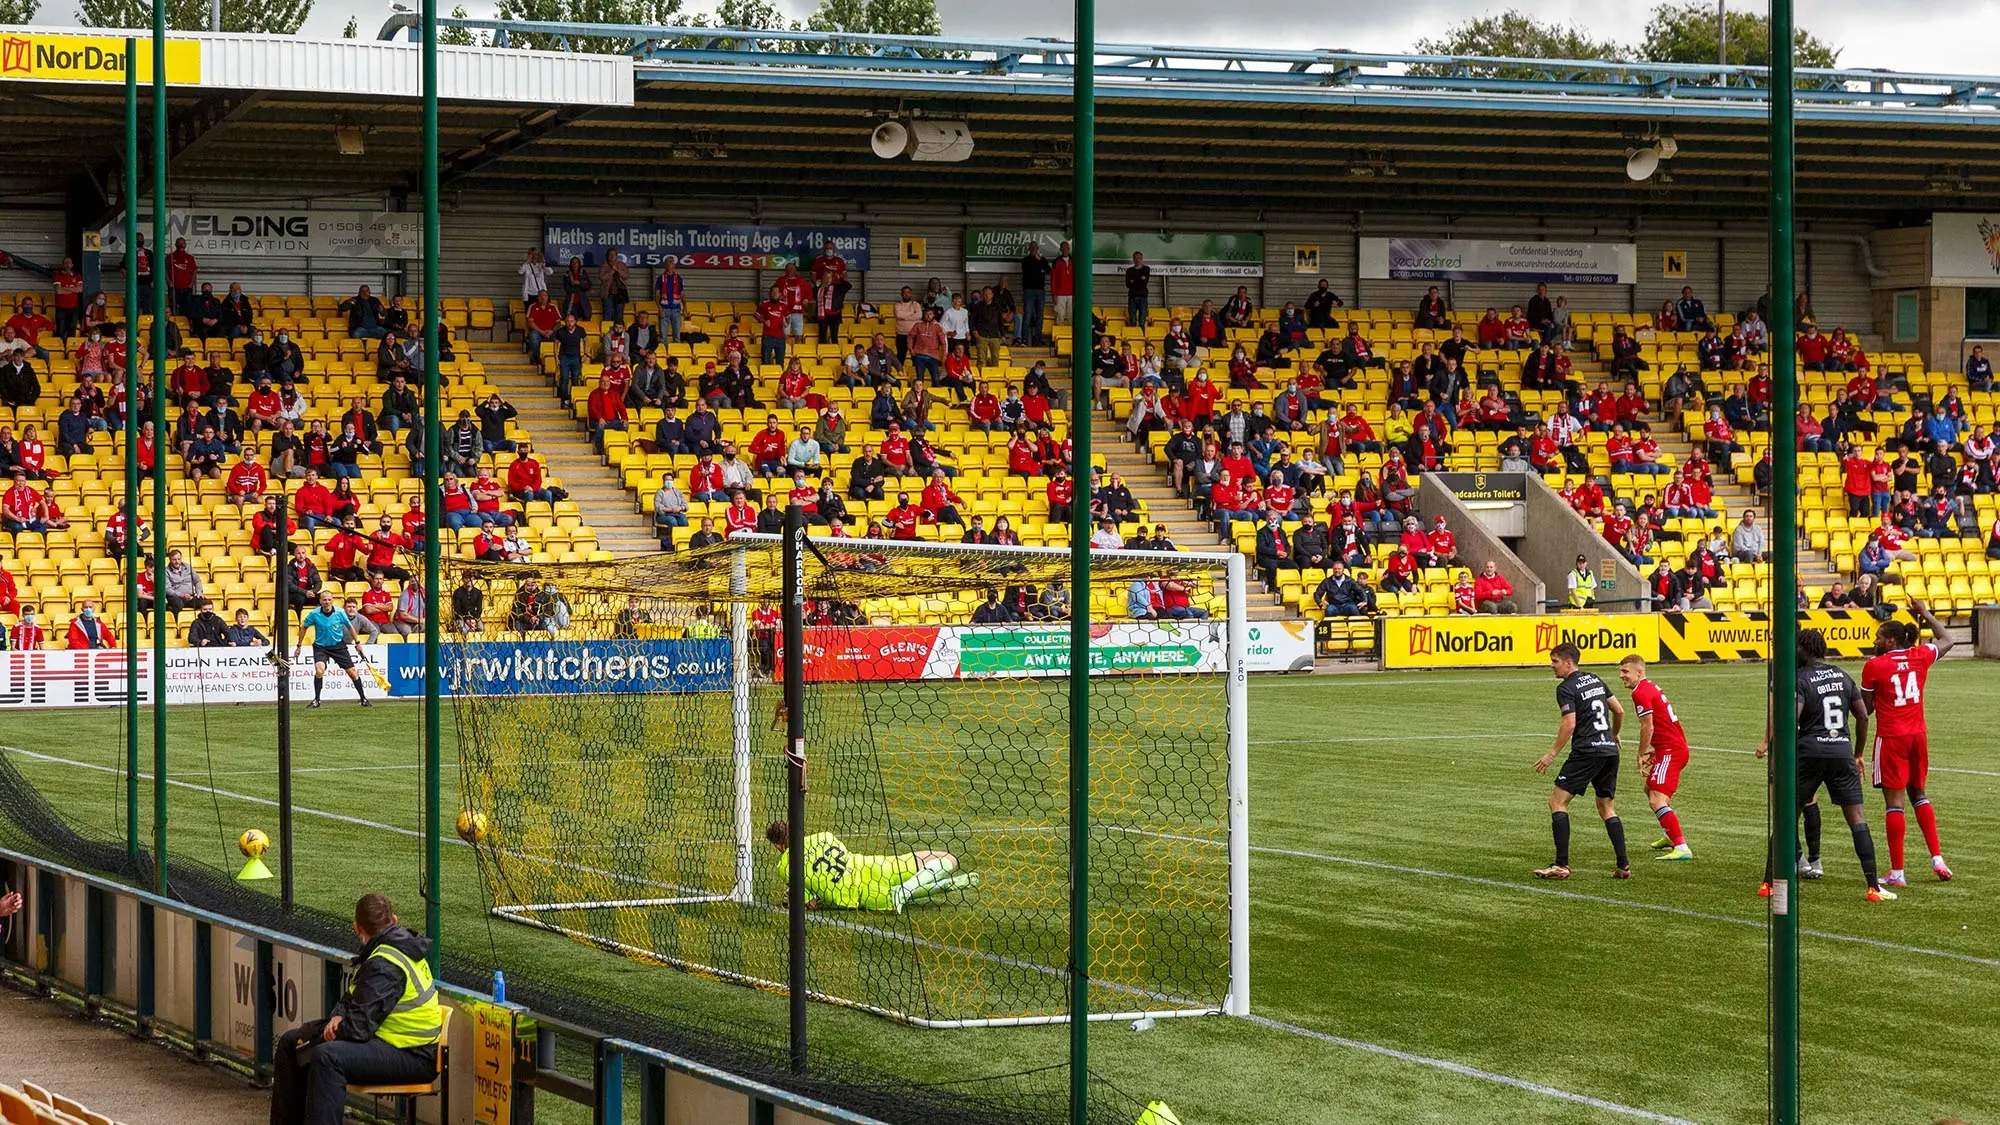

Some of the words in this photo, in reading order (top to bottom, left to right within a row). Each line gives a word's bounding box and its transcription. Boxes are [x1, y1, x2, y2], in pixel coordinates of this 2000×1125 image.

[318, 222, 364, 232] 01506
[85, 235, 96, 248] K
[548, 227, 594, 245] Maths
[598, 228, 625, 246] and
[630, 228, 684, 249] English
[688, 229, 749, 252] Tutoring
[752, 231, 781, 252] Age
[783, 231, 794, 248] 4
[806, 231, 823, 249] 18
[977, 231, 1046, 246] MUIRHALL
[977, 240, 1020, 251] ENERGY
[906, 241, 920, 259] L
[1297, 249, 1317, 266] M
[1509, 246, 1549, 256] Confidential
[1550, 246, 1583, 258] Shredding
[616, 254, 696, 266] 01506
[1393, 254, 1462, 269] secureshred
[1668, 255, 1681, 272] N
[1215, 266, 1242, 275] Football
[1243, 266, 1258, 275] Club
[1492, 489, 1521, 498] Toilet's
[794, 541, 804, 596] HARROD
[1318, 626, 1328, 635] 18
[1435, 630, 1514, 653] NorDan
[1561, 628, 1637, 650] NorDan
[776, 644, 825, 658] GN'S
[879, 641, 929, 657] GLEN'S
[1247, 644, 1274, 656] ridor
[165, 658, 211, 668] JOHN
[216, 656, 270, 668] HEANE
[1024, 653, 1052, 667] ANY
[1896, 661, 1910, 671] JET
[165, 671, 228, 680] LECTRICAL
[231, 671, 239, 679] &
[241, 670, 316, 679] MECHICAL
[1237, 659, 1245, 682] PRO
[290, 681, 311, 691] TEL:
[324, 681, 342, 690] 506
[1890, 671, 1920, 707] 14
[1590, 699, 1609, 731] 3
[1822, 695, 1845, 730] 6
[233, 961, 298, 1023] wlo
[479, 1008, 506, 1032] SNACK
[484, 1031, 501, 1052] BAR
[520, 1038, 531, 1062] 11
[476, 1075, 508, 1102] TOILETS
